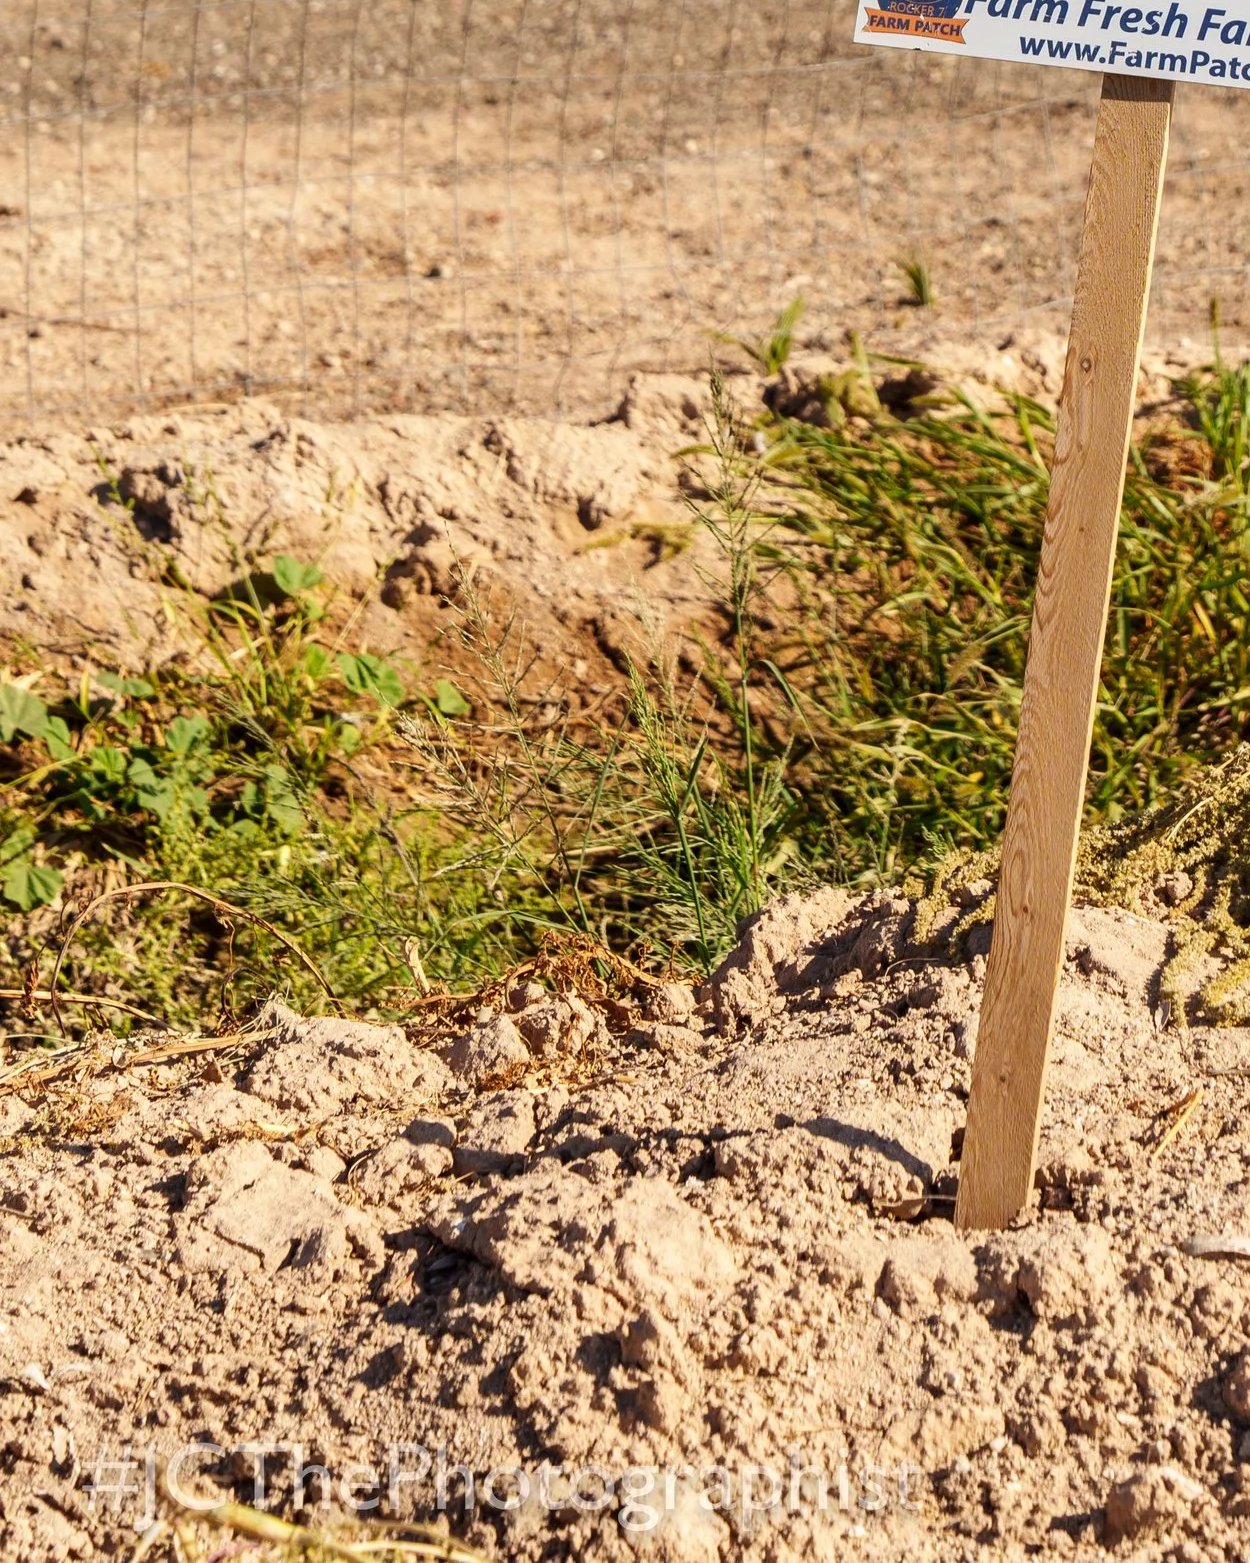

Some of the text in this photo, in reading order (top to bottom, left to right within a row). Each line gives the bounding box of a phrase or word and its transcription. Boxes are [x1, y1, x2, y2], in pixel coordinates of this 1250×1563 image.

[890, 1, 935, 16] ROCKER
[869, 15, 961, 37] FARM PATCH
